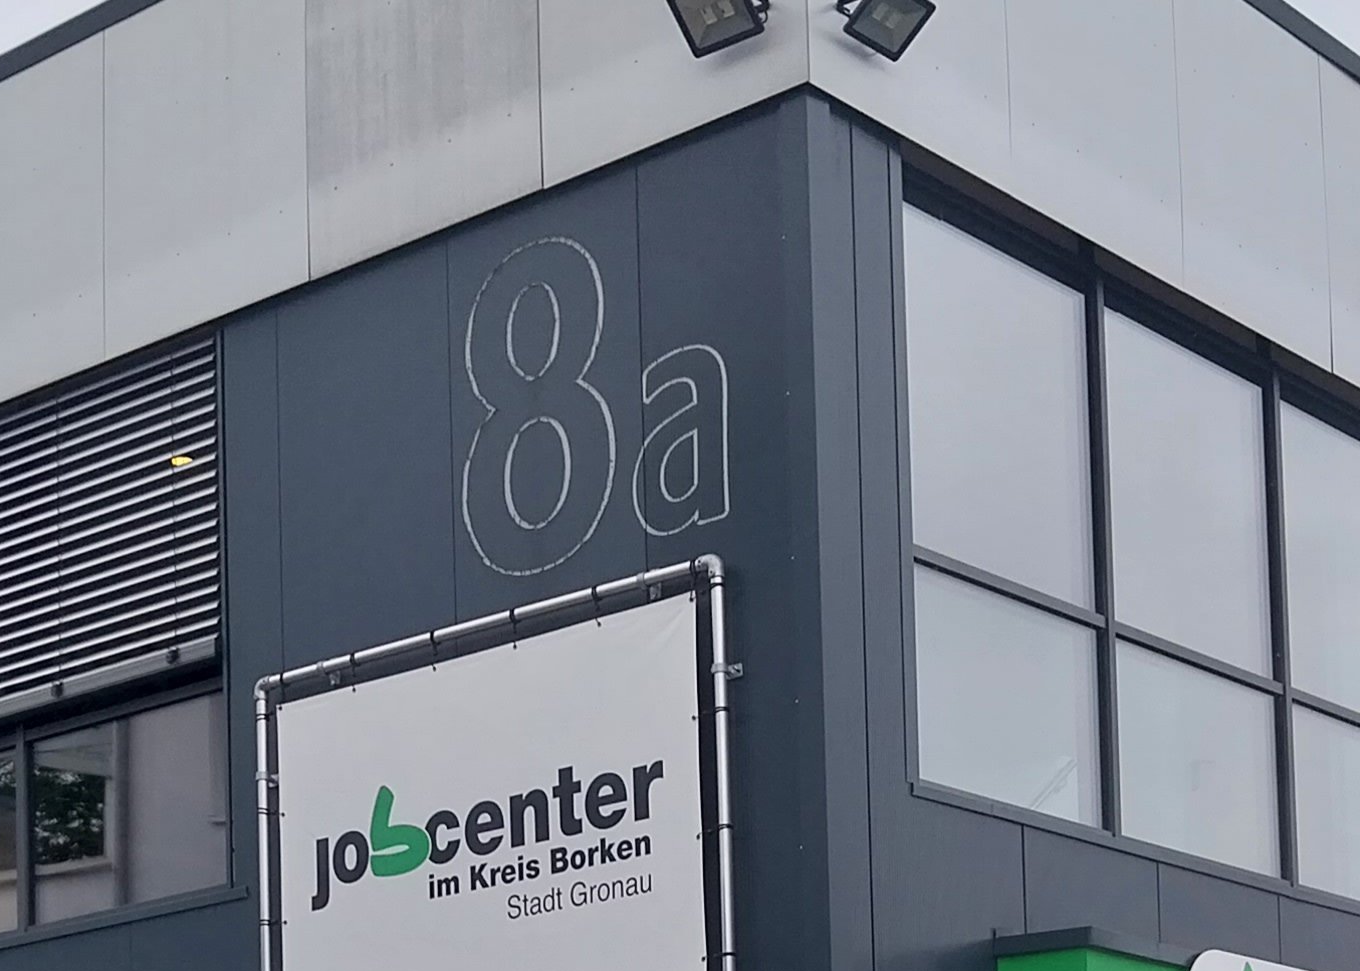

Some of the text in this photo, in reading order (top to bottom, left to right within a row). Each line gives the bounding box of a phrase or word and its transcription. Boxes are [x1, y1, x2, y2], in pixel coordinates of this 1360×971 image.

[462, 236, 730, 576] 8a
[311, 760, 664, 911] jobcenter
[429, 835, 652, 899] im Kreis Borken
[507, 873, 652, 920] Stadt Gronau
